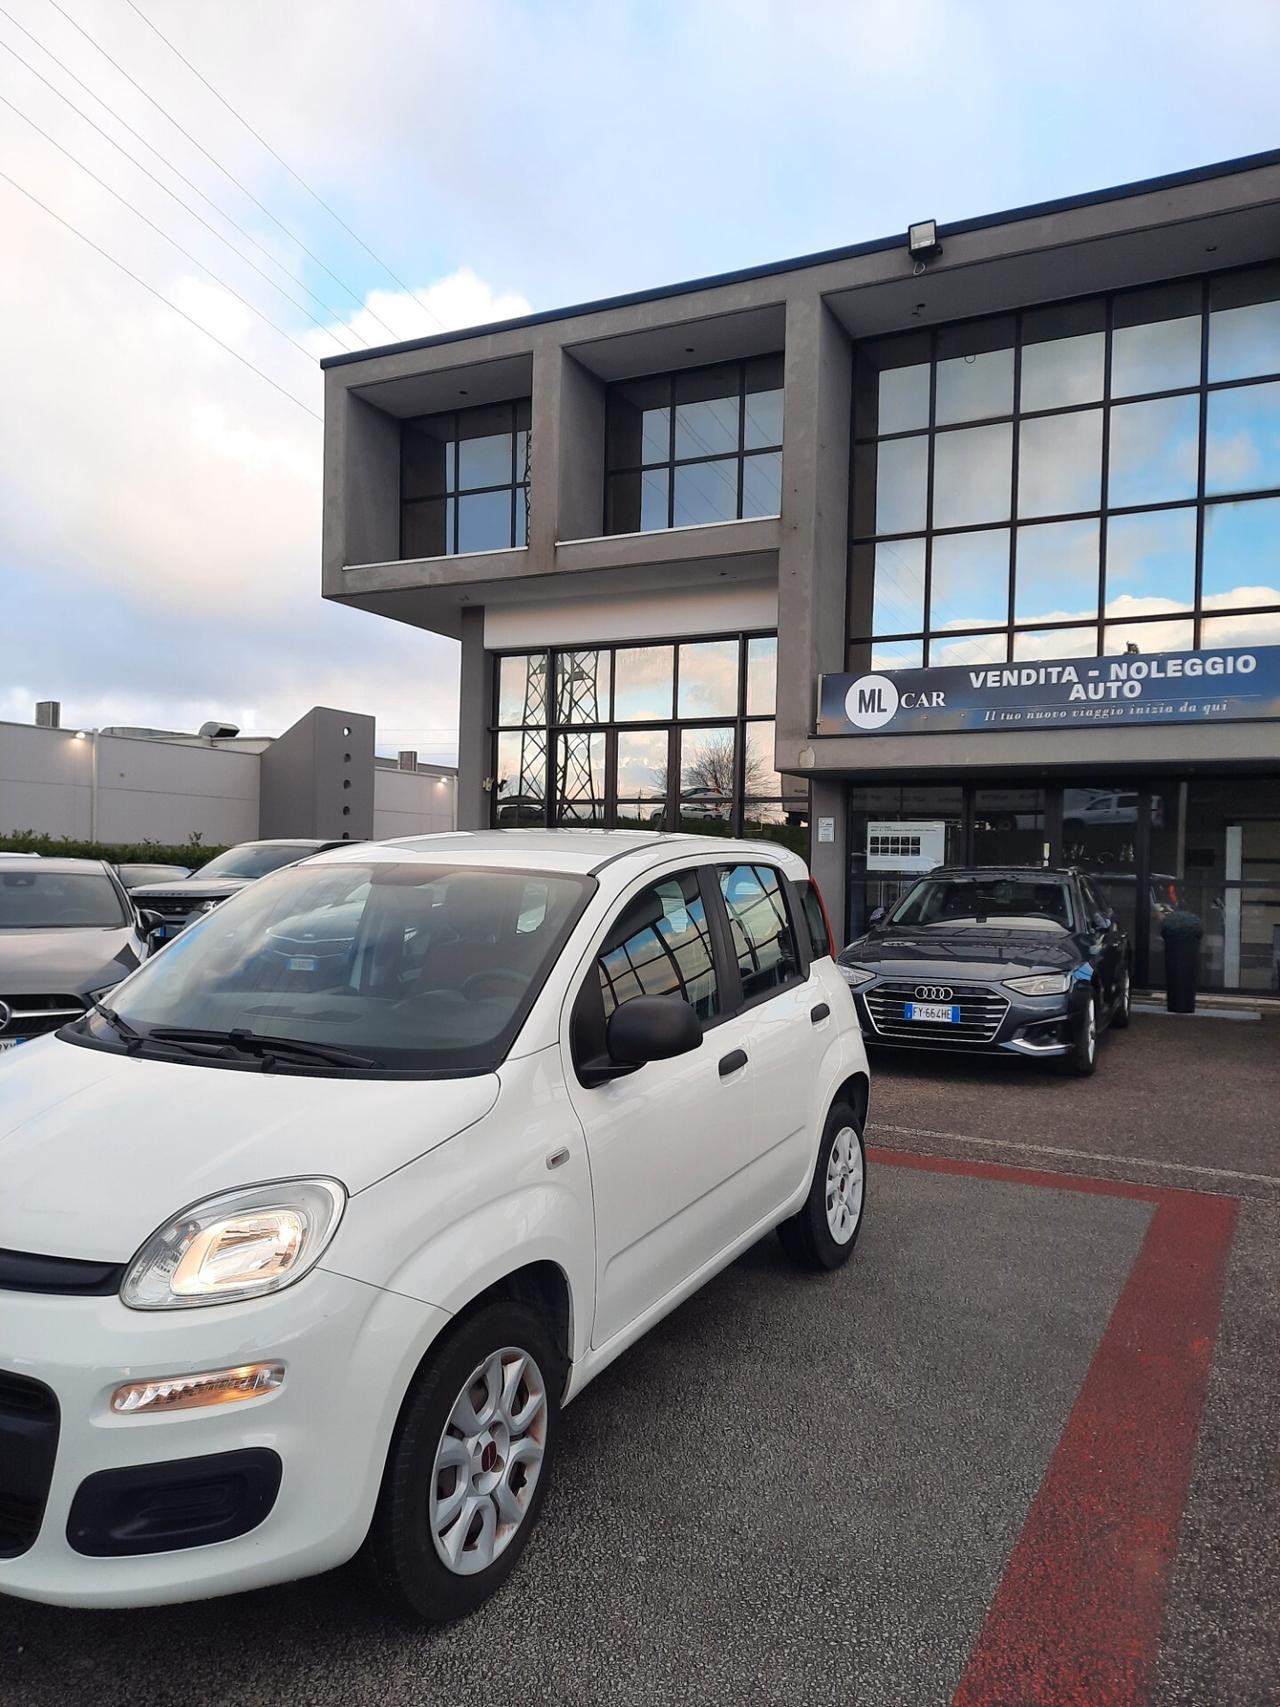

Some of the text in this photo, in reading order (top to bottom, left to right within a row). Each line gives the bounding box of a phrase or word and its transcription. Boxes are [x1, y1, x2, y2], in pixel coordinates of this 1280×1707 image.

[969, 666, 1079, 688] VENDITA
[1110, 655, 1257, 680] NOLEGGIO
[858, 688, 947, 714] ML CAR
[1068, 680, 1142, 701] AUTO
[984, 700, 1229, 721] Il tuo nuovo viaggio inizia da qui
